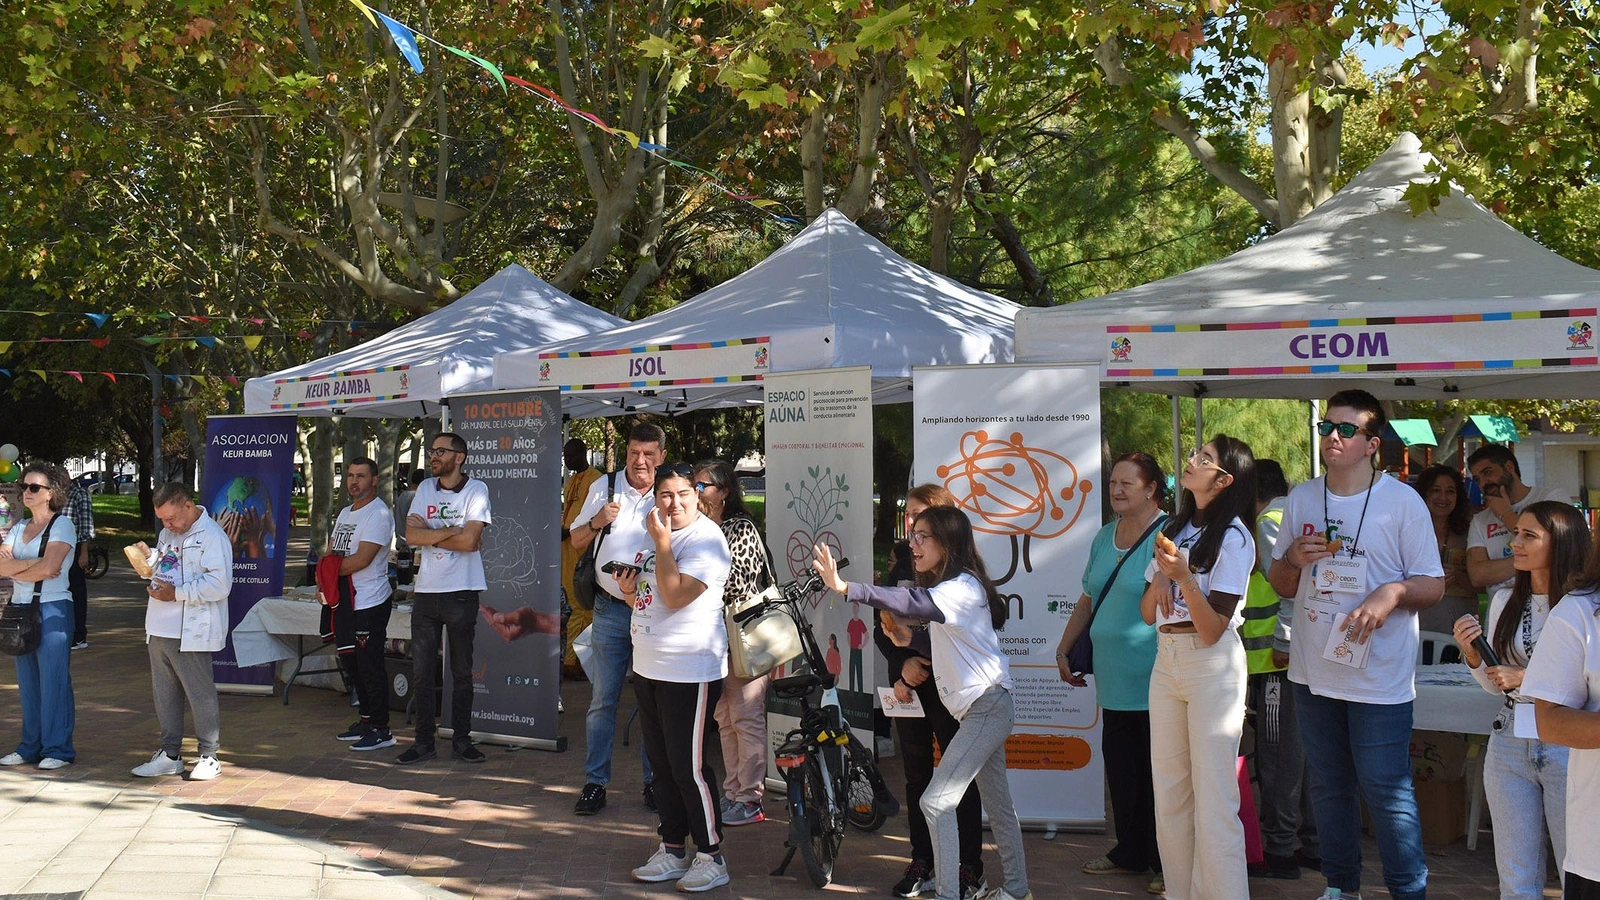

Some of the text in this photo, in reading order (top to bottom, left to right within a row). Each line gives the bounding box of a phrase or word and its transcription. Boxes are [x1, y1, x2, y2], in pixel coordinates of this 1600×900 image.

[1289, 332, 1389, 359] CEOM
[629, 357, 666, 377] ISOL
[305, 378, 371, 398] KEUR BAMBA
[768, 390, 806, 402] ESPACIO
[464, 400, 543, 419] 10 OCTUBRE
[769, 404, 806, 423] AÚNA
[493, 420, 500, 428] DE
[501, 420, 507, 428] LA
[508, 419, 524, 428] SALUD
[922, 416, 964, 425] Ampliando
[212, 434, 288, 446] ASOCIACION
[466, 436, 536, 450] MÁS DE 20 AÑOS
[222, 449, 272, 458] KEUR BAMBA
[464, 454, 538, 464] TRABAJANDO POR
[476, 469, 504, 479] SALUD
[506, 468, 538, 478] MENTAL
